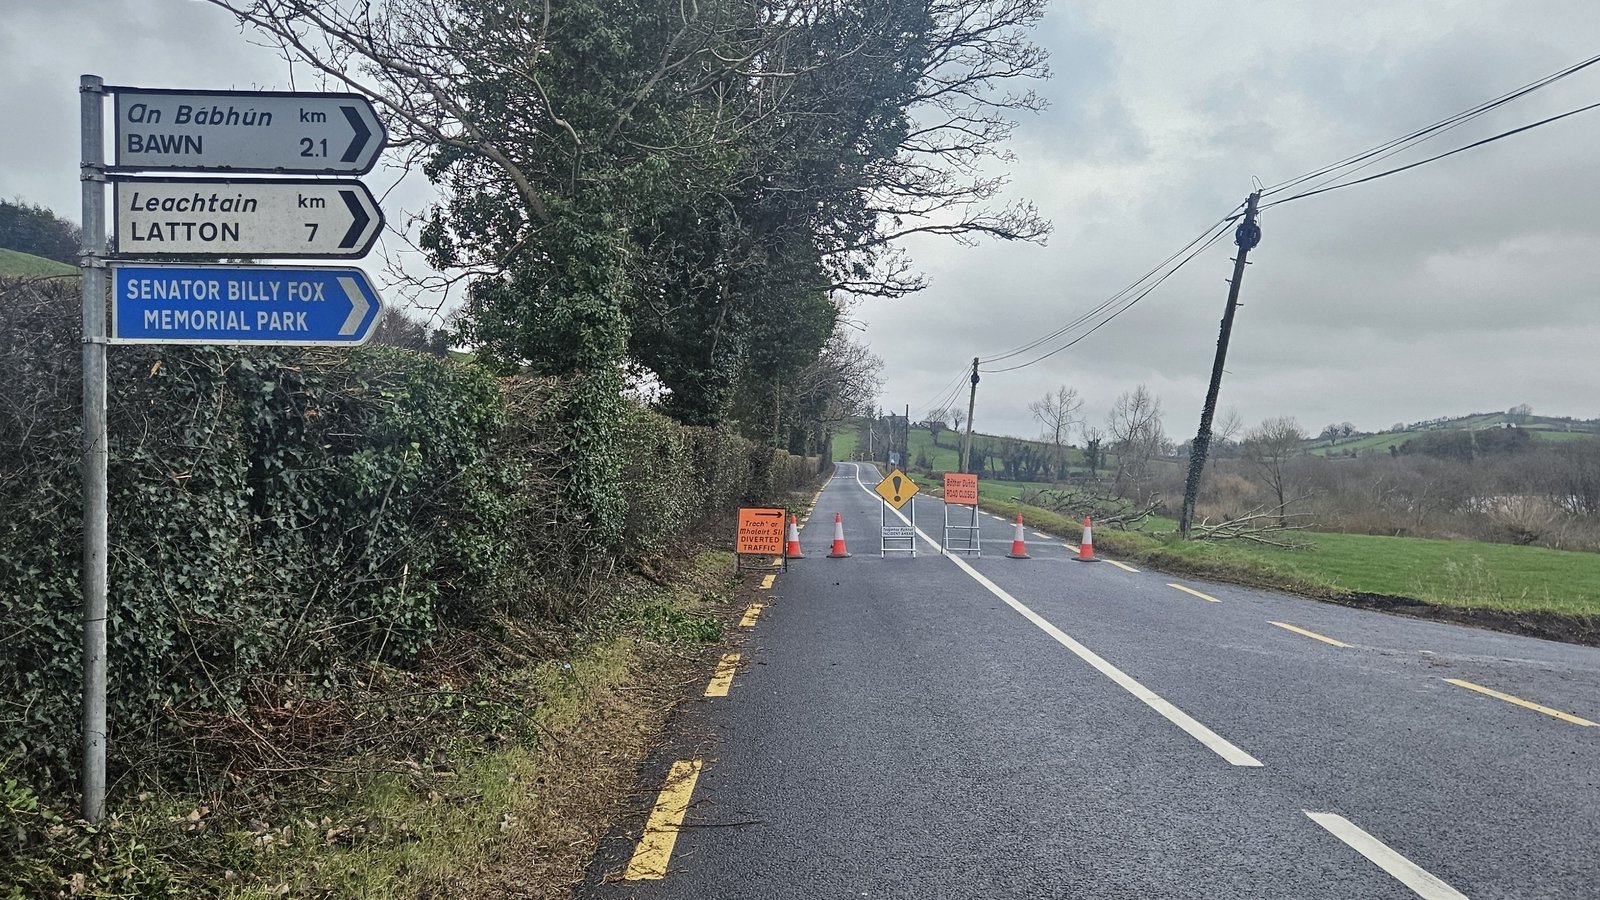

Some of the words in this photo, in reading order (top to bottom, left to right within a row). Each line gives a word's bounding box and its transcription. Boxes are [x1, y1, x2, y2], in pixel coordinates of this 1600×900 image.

[127, 103, 161, 124] An
[174, 105, 273, 127] Bábhún
[299, 108, 327, 123] km
[127, 133, 203, 155] BAWN
[299, 138, 328, 157] 2.1
[130, 192, 257, 213] Leachtain
[298, 194, 326, 209] km
[131, 222, 240, 242] LATTON
[304, 223, 319, 242] 7
[126, 279, 220, 301] SENATOR
[227, 281, 281, 303] BILLY
[287, 282, 325, 302] FOX
[144, 309, 250, 332] MEMORIAL
[256, 311, 309, 332] PARK
